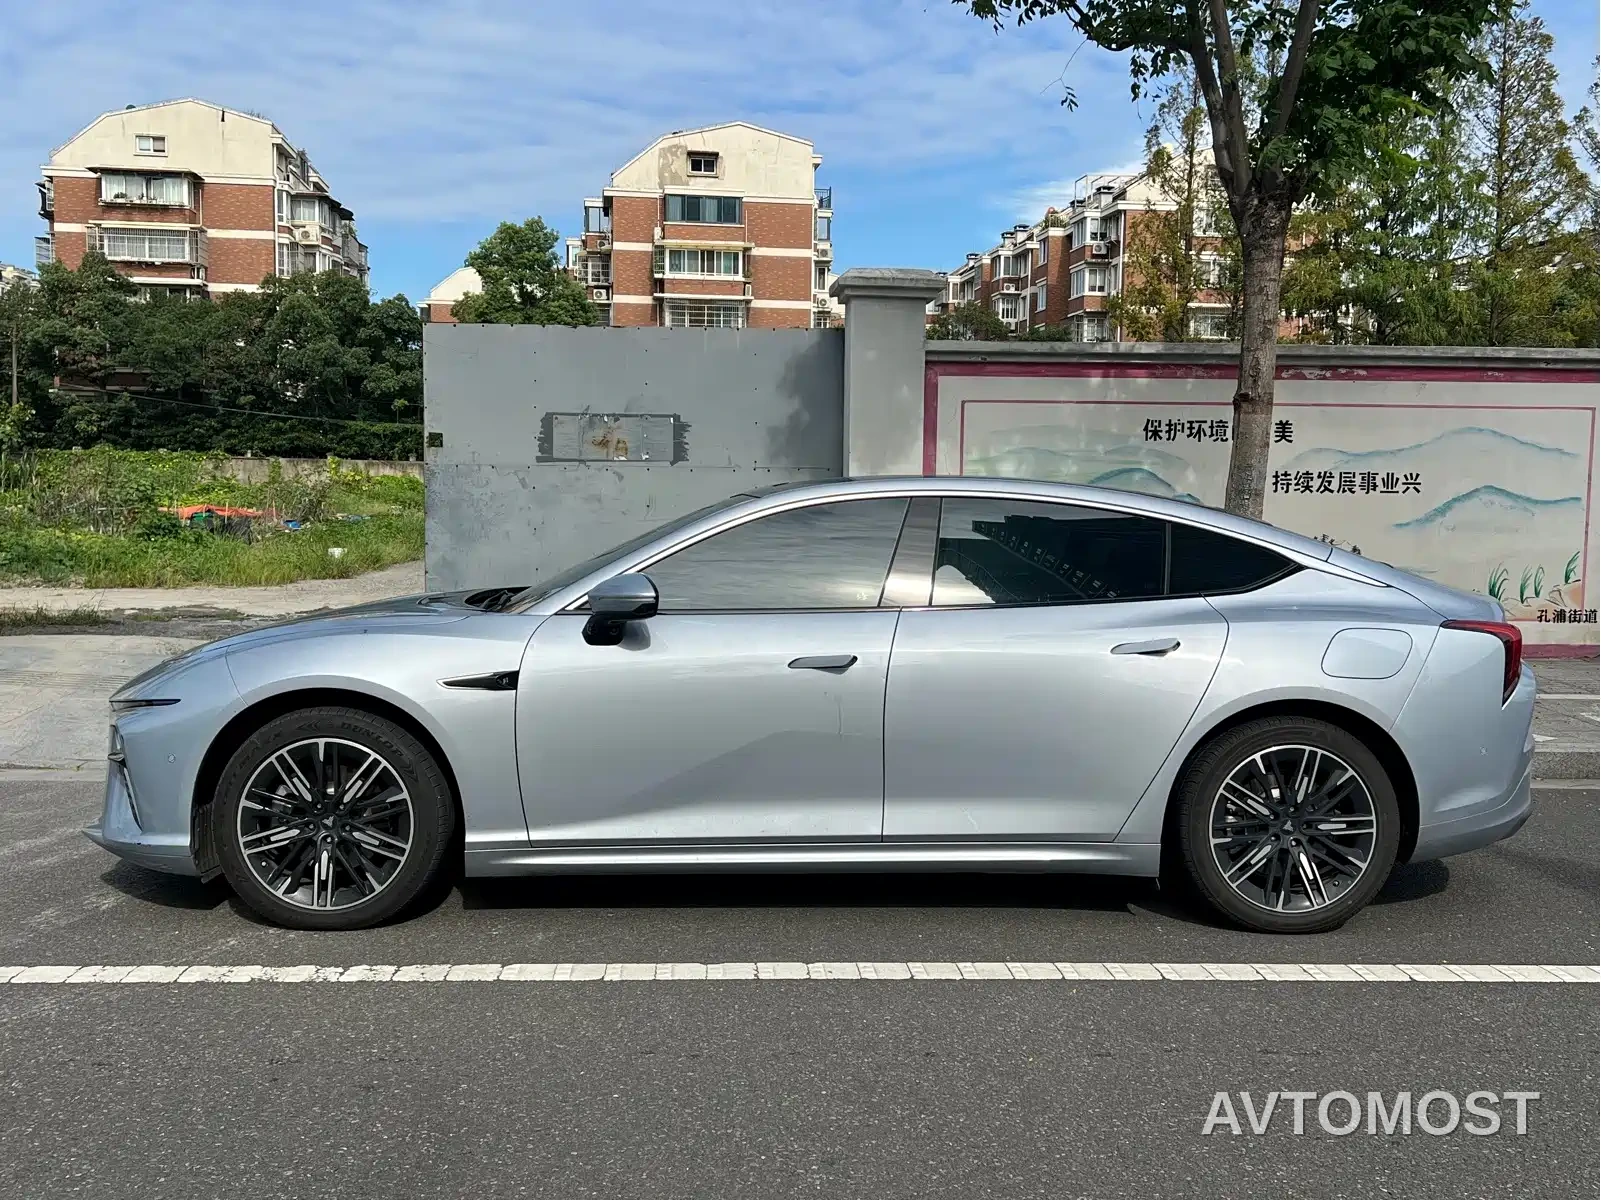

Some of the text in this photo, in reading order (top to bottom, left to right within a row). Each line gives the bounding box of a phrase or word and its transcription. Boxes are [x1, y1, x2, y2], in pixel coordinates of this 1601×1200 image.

[1143, 418, 1293, 444] 保护环境美
[1272, 470, 1421, 495] 持续发展事业兴
[1537, 608, 1598, 624] 孔浦街道
[341, 721, 404, 757] DUNLOP
